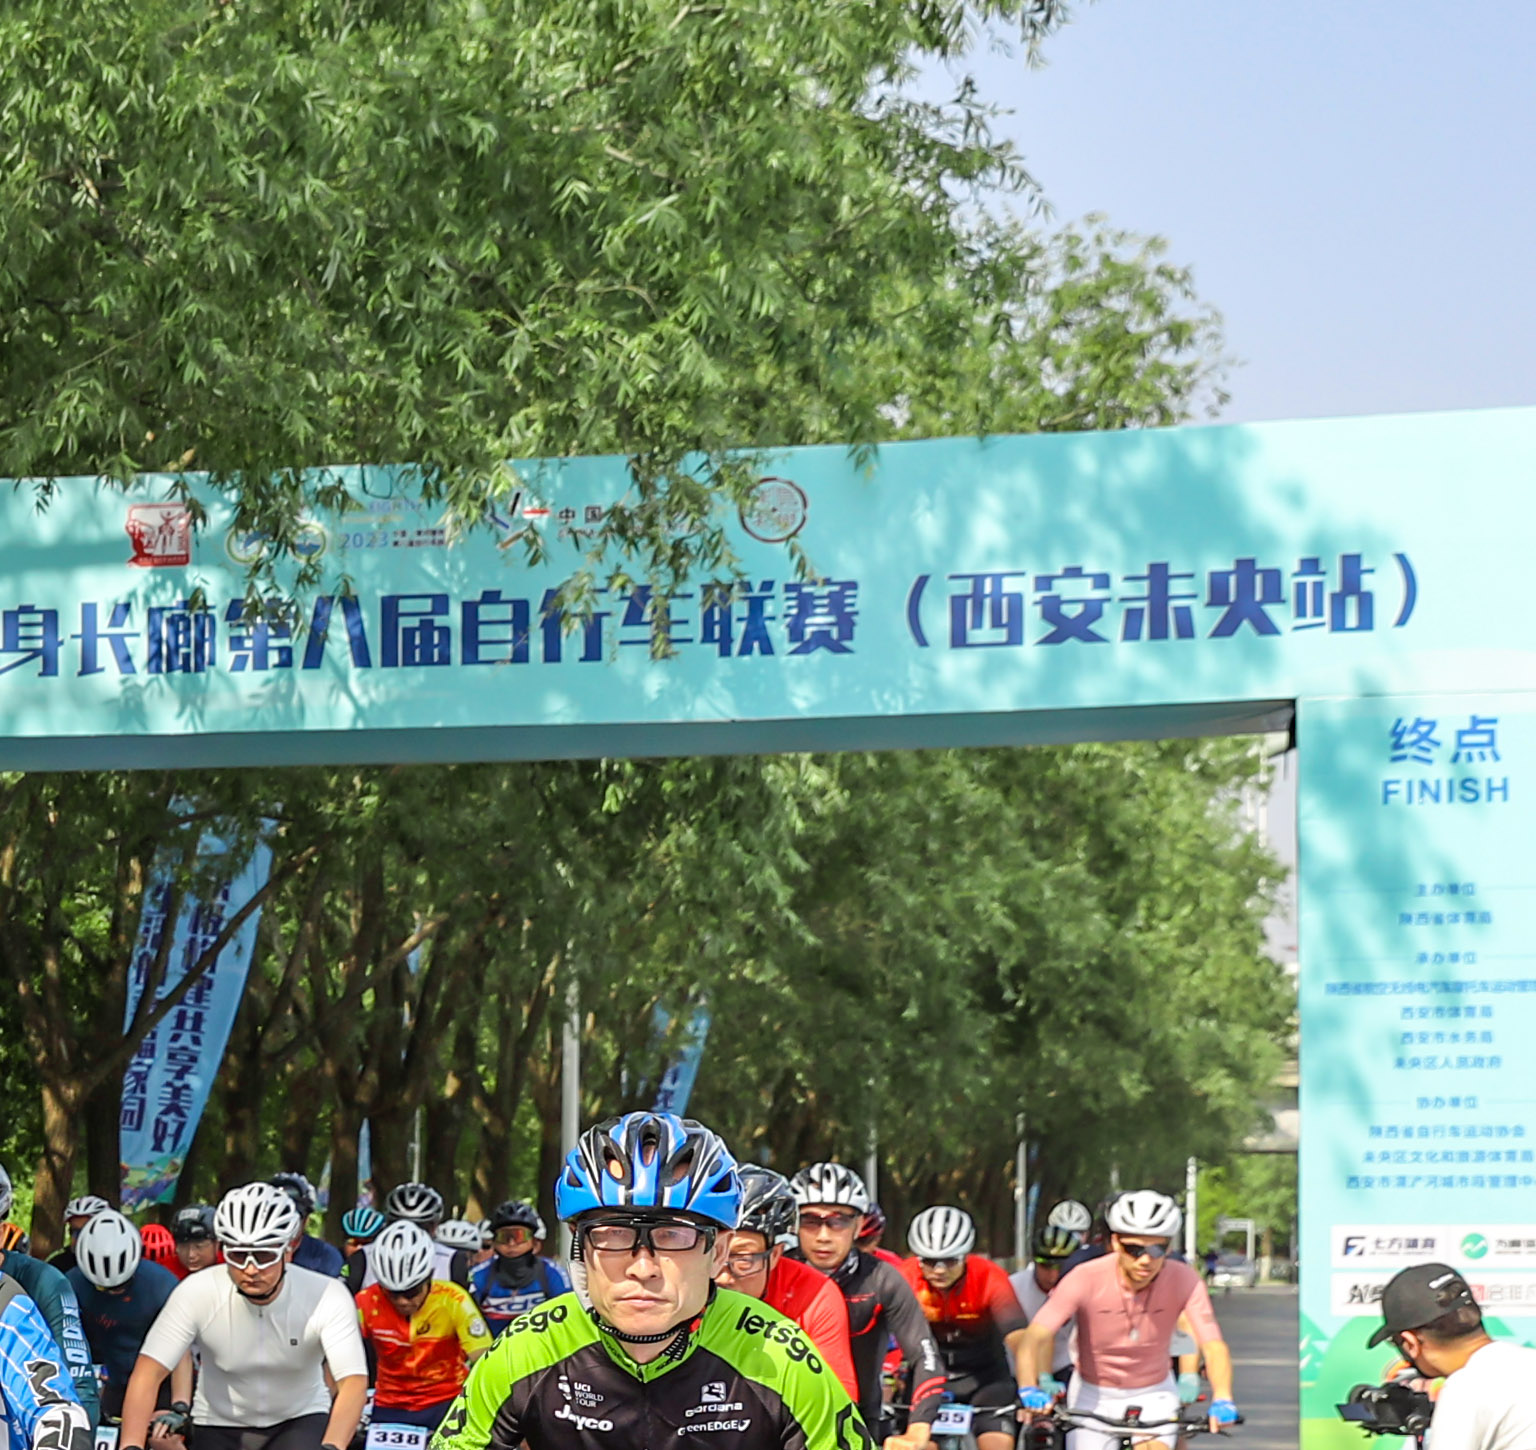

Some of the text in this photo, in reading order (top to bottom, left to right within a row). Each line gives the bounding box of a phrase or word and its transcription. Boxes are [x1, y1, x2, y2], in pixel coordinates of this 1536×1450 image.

[1389, 714, 1501, 765] 终点
[1382, 776, 1510, 805] FINISH
[735, 1306, 823, 1376] letsgo
[574, 1381, 591, 1392] UCI
[575, 1392, 604, 1402] WORLD
[373, 1430, 420, 1447] 338
